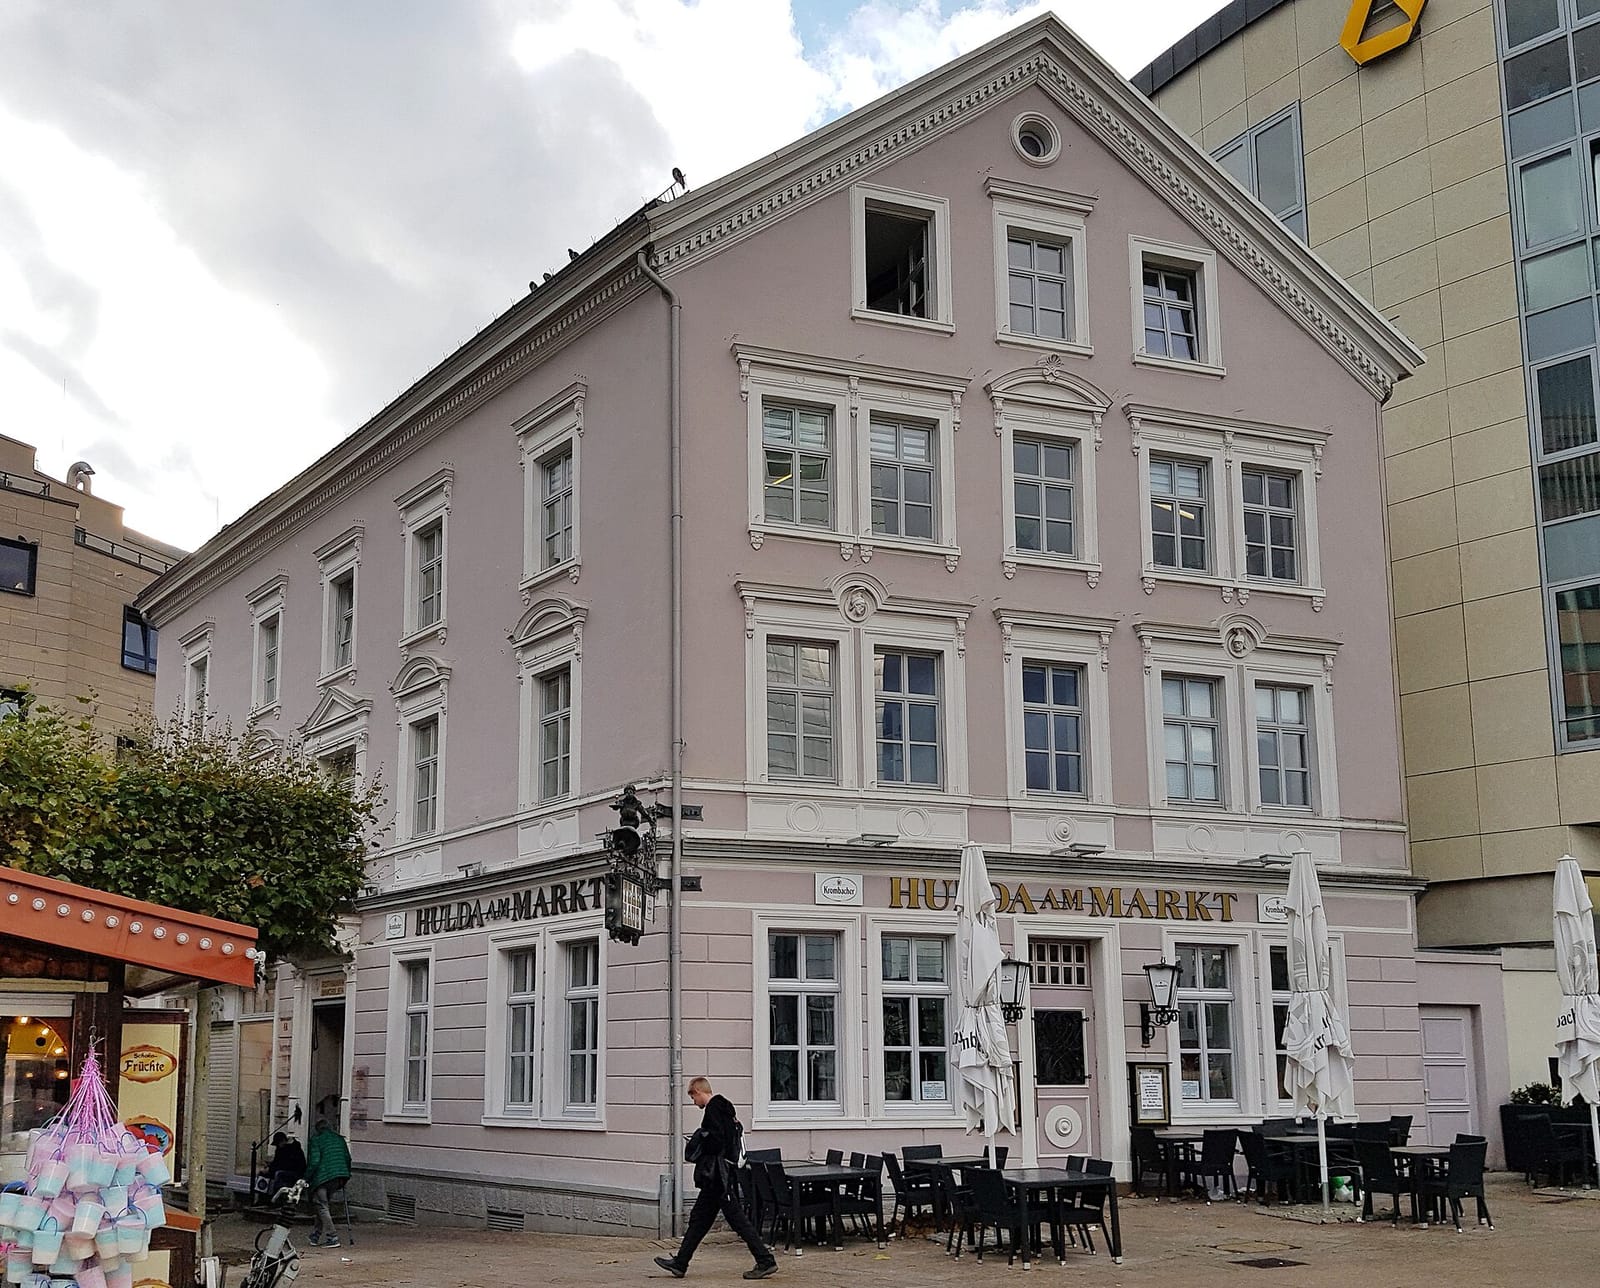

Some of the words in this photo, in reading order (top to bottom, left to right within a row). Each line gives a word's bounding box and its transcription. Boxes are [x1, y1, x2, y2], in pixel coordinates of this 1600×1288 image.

[823, 885, 855, 895] Krombacher
[888, 876, 1039, 915] HUDA
[1039, 886, 1084, 911] AM
[1088, 886, 1239, 922] MARKT
[415, 899, 485, 937] HULDA
[485, 896, 511, 921] AM
[511, 876, 605, 922] MARKT
[123, 1060, 165, 1072] Früchte
